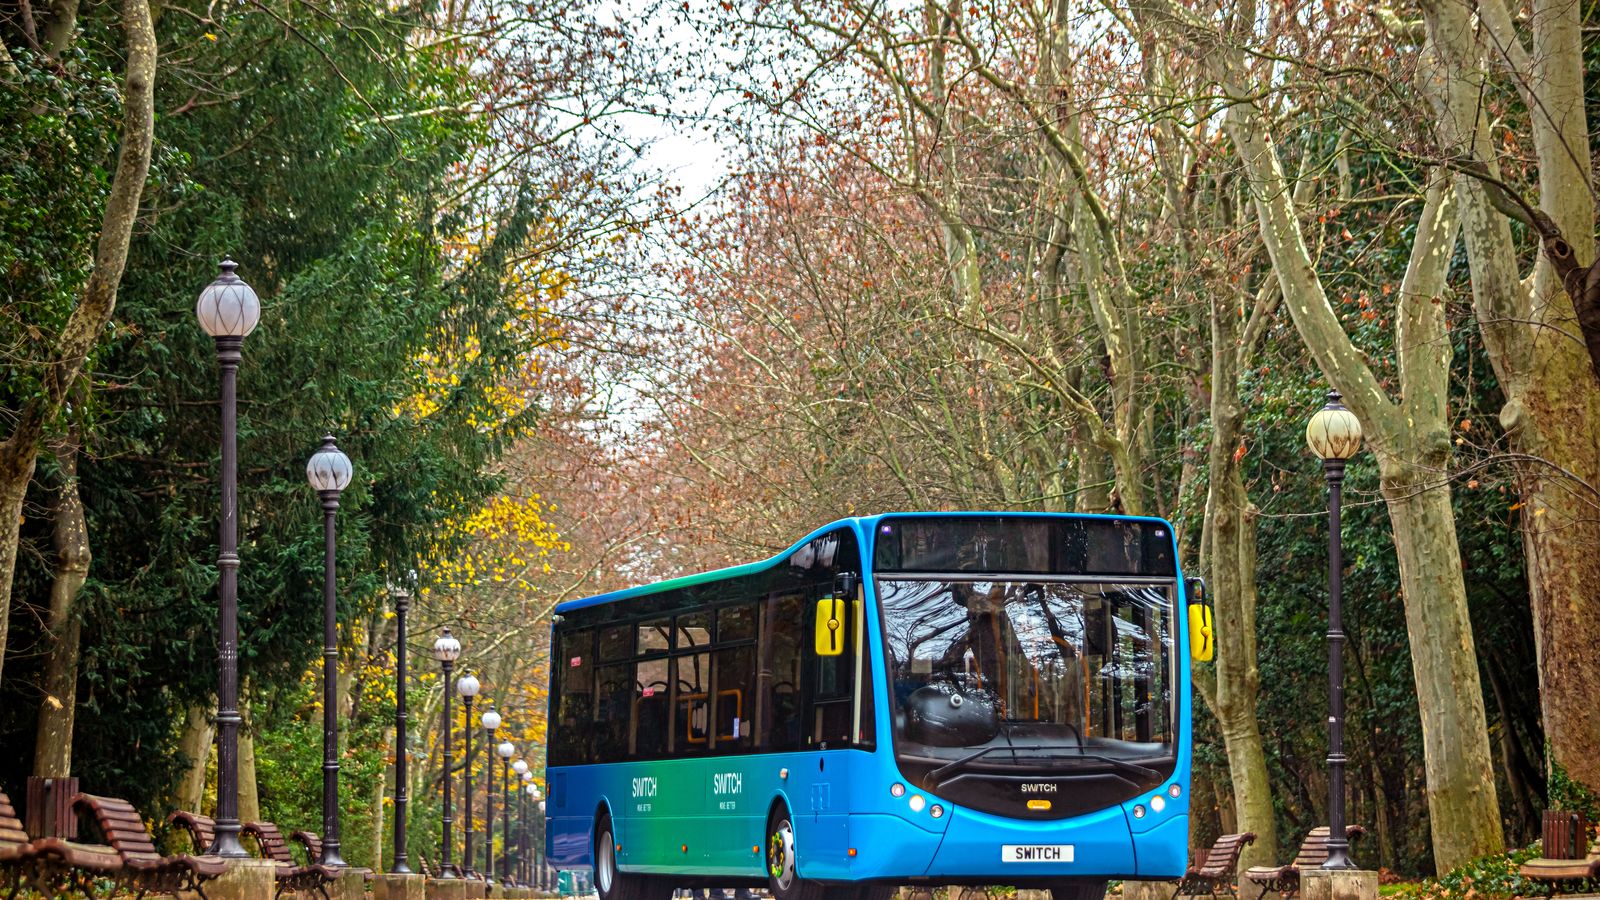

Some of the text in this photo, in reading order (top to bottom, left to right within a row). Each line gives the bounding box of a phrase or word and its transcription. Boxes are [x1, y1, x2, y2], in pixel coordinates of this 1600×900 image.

[632, 776, 658, 798] SWITCH
[713, 772, 742, 794] SWITCH
[1021, 783, 1057, 792] SWITCH
[1015, 847, 1060, 860] SWITCH
